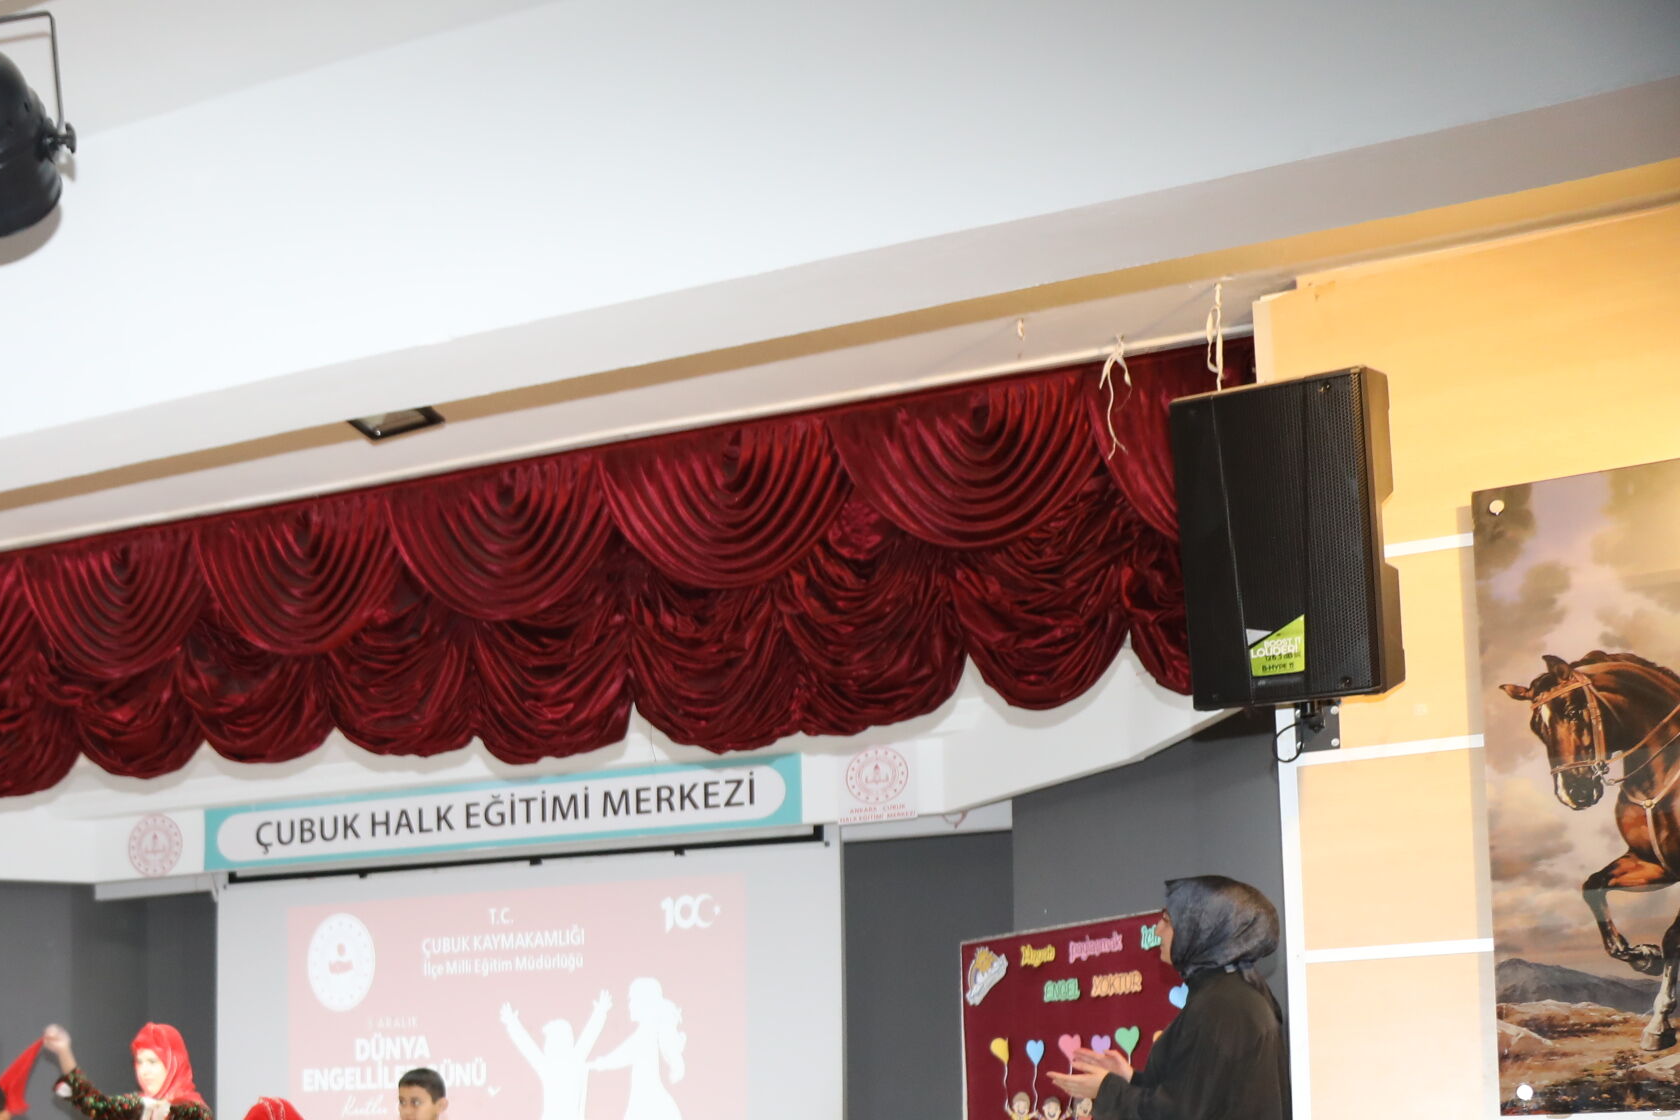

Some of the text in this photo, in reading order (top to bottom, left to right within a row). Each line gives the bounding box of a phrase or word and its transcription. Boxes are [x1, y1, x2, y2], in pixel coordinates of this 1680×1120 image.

[255, 771, 756, 855] ÇUBUK HALK EĞİTİMİ MERKEZİ
[488, 907, 514, 925] T.C.
[422, 923, 585, 958] ÇUBUK KAYMAKAMLIĞI
[1091, 969, 1142, 997] YOKTUR
[355, 1032, 431, 1063] DÜNYA
